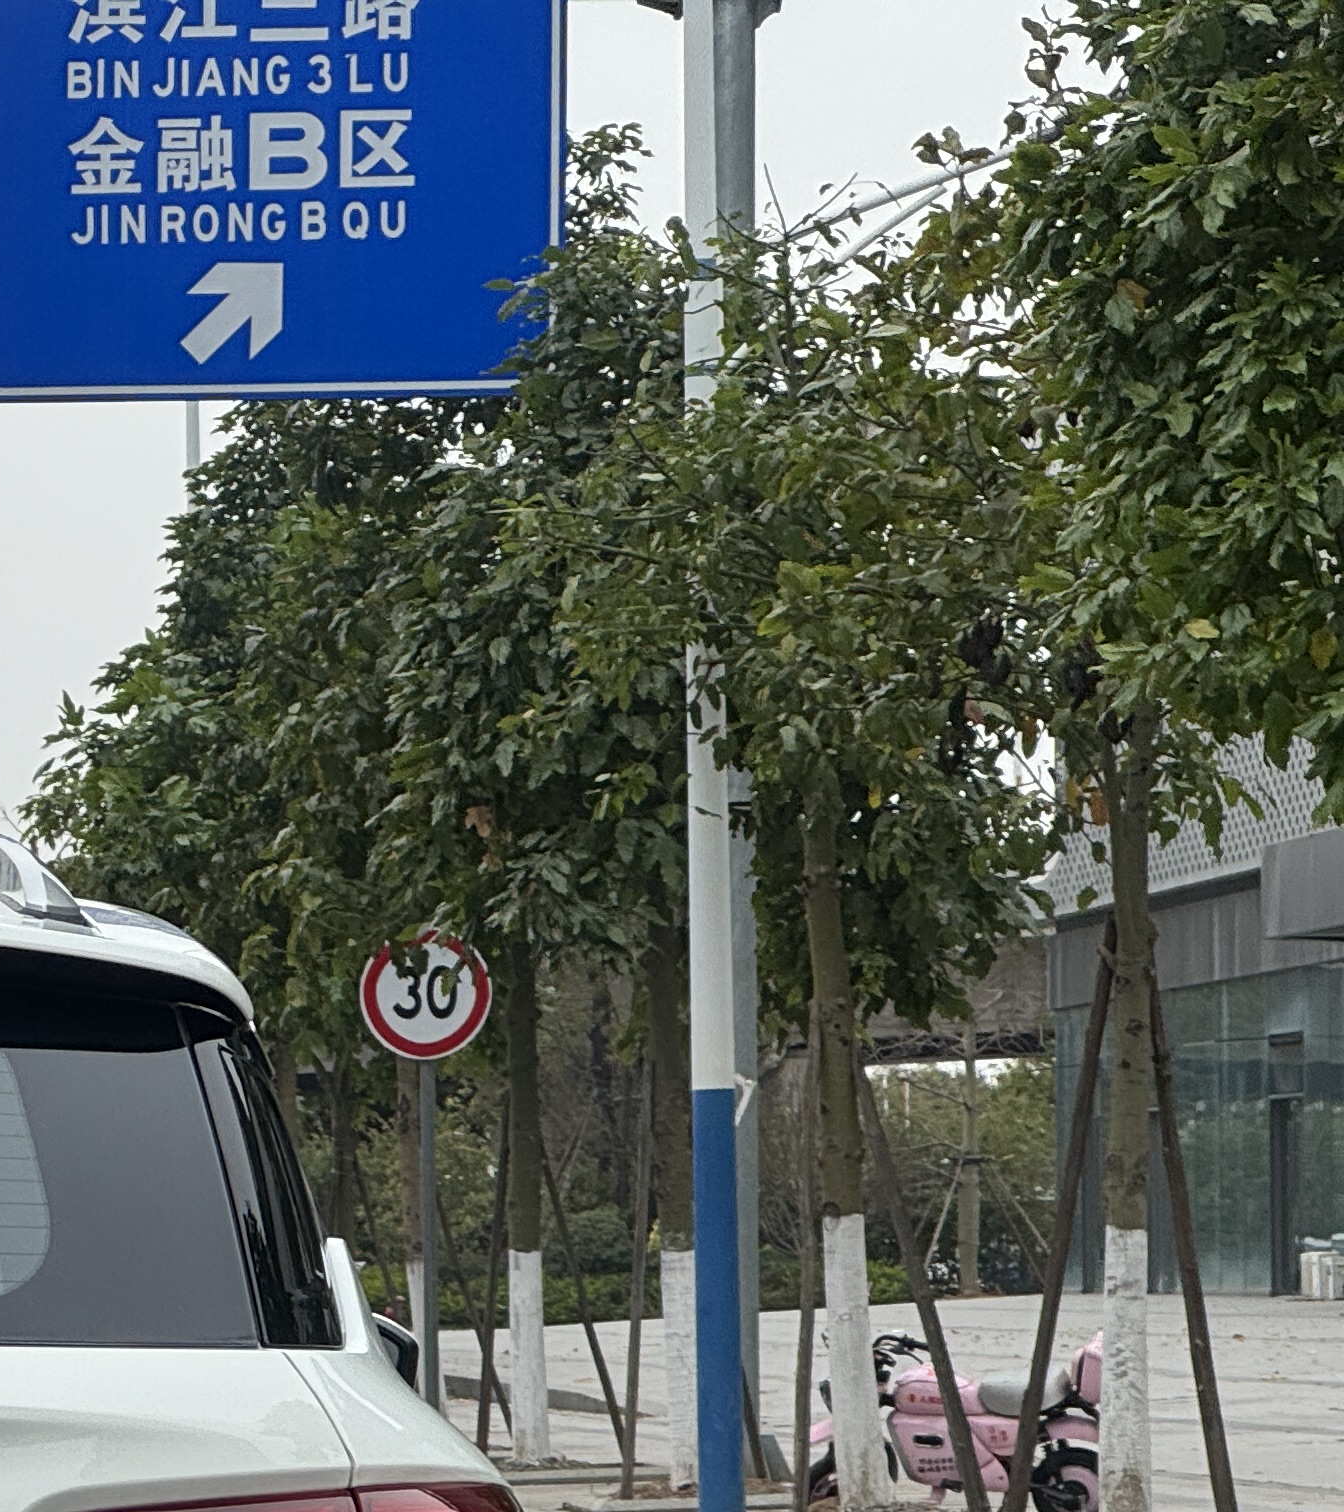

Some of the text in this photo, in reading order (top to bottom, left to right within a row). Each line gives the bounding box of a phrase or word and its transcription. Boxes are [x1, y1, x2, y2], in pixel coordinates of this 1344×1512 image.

[66, 59, 140, 100] BIN
[152, 55, 291, 98] JIANG
[307, 55, 333, 94] 3
[68, 108, 416, 195] 金融B区
[70, 203, 148, 245] JIN
[160, 201, 287, 244] RONG
[301, 200, 327, 241] B
[392, 964, 459, 1020] 30
